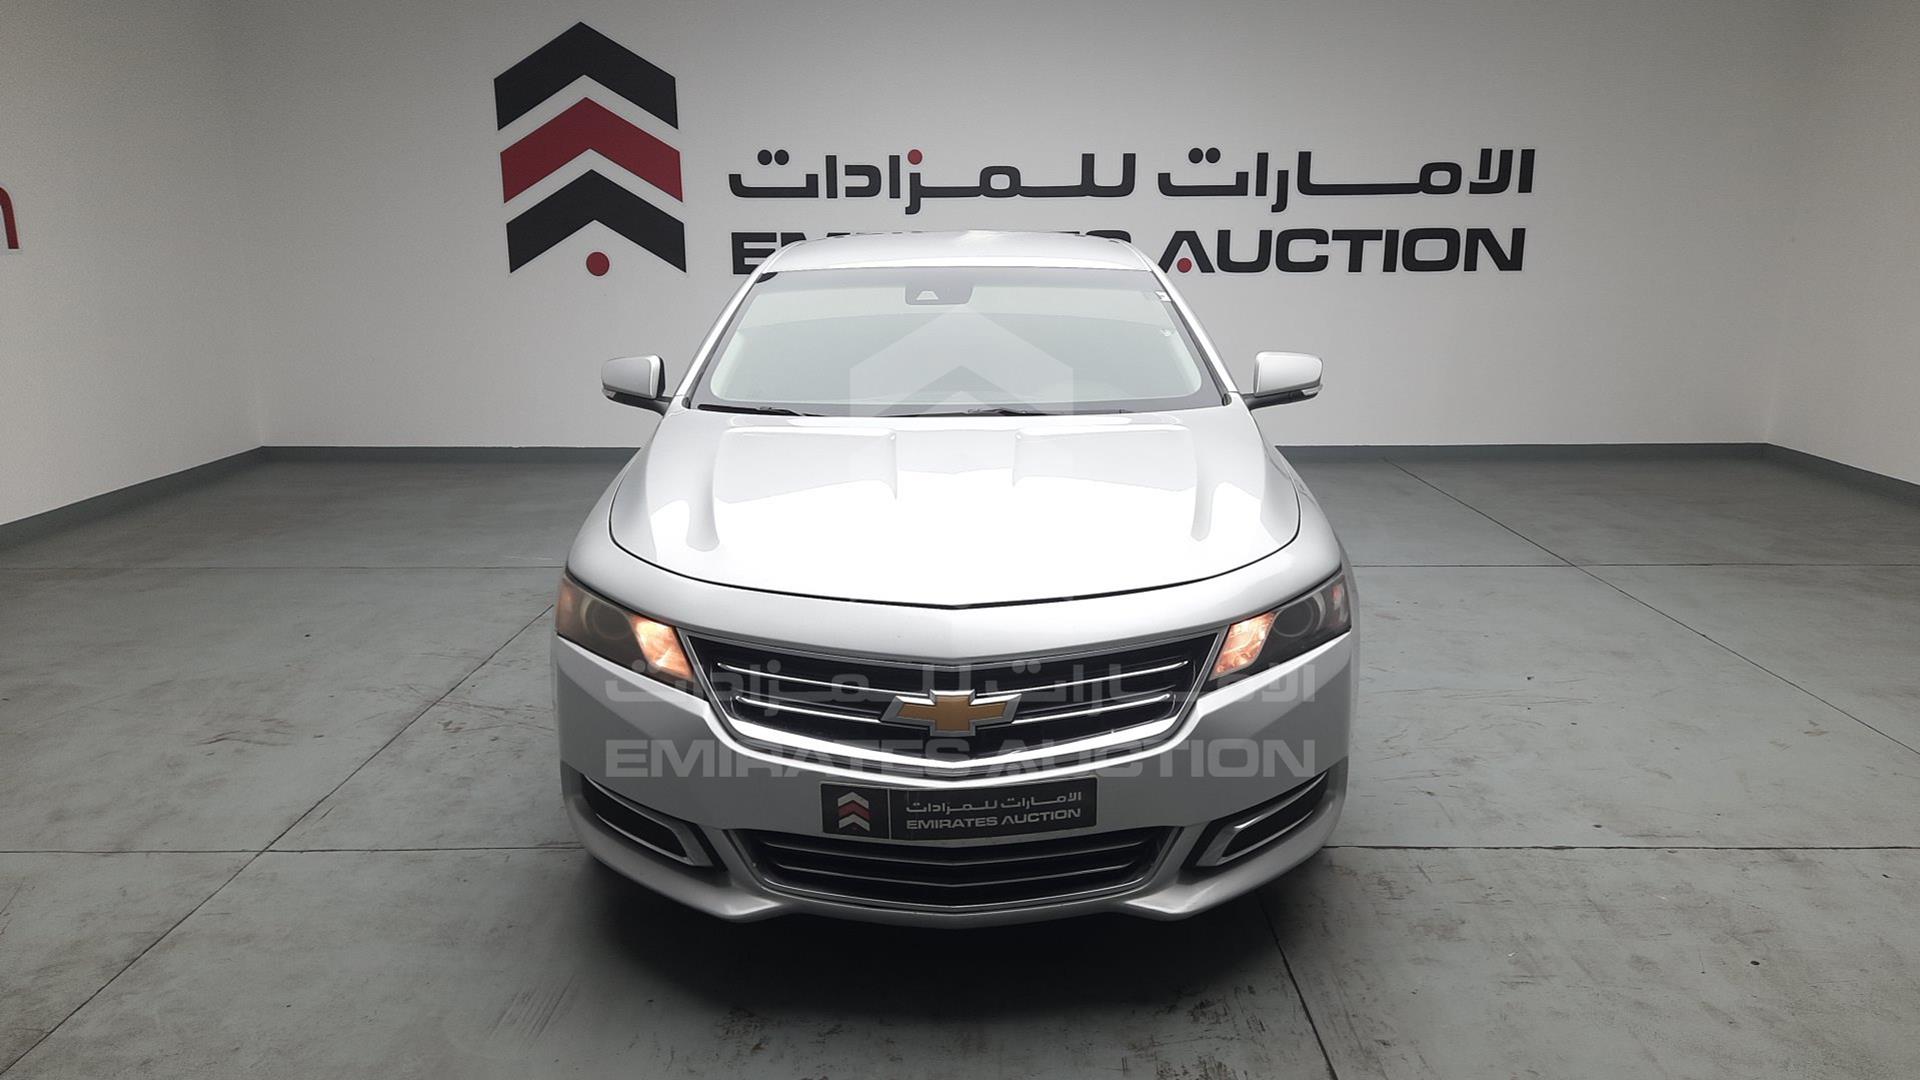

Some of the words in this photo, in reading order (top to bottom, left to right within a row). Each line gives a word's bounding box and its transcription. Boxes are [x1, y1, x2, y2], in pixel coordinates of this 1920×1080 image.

[728, 148, 1137, 215] للمزادات
[1157, 147, 1536, 213] الامارات
[1158, 227, 1526, 273] AUCTION
[906, 816, 998, 830] EMIRATES
[1000, 808, 1081, 825] AUCTION
